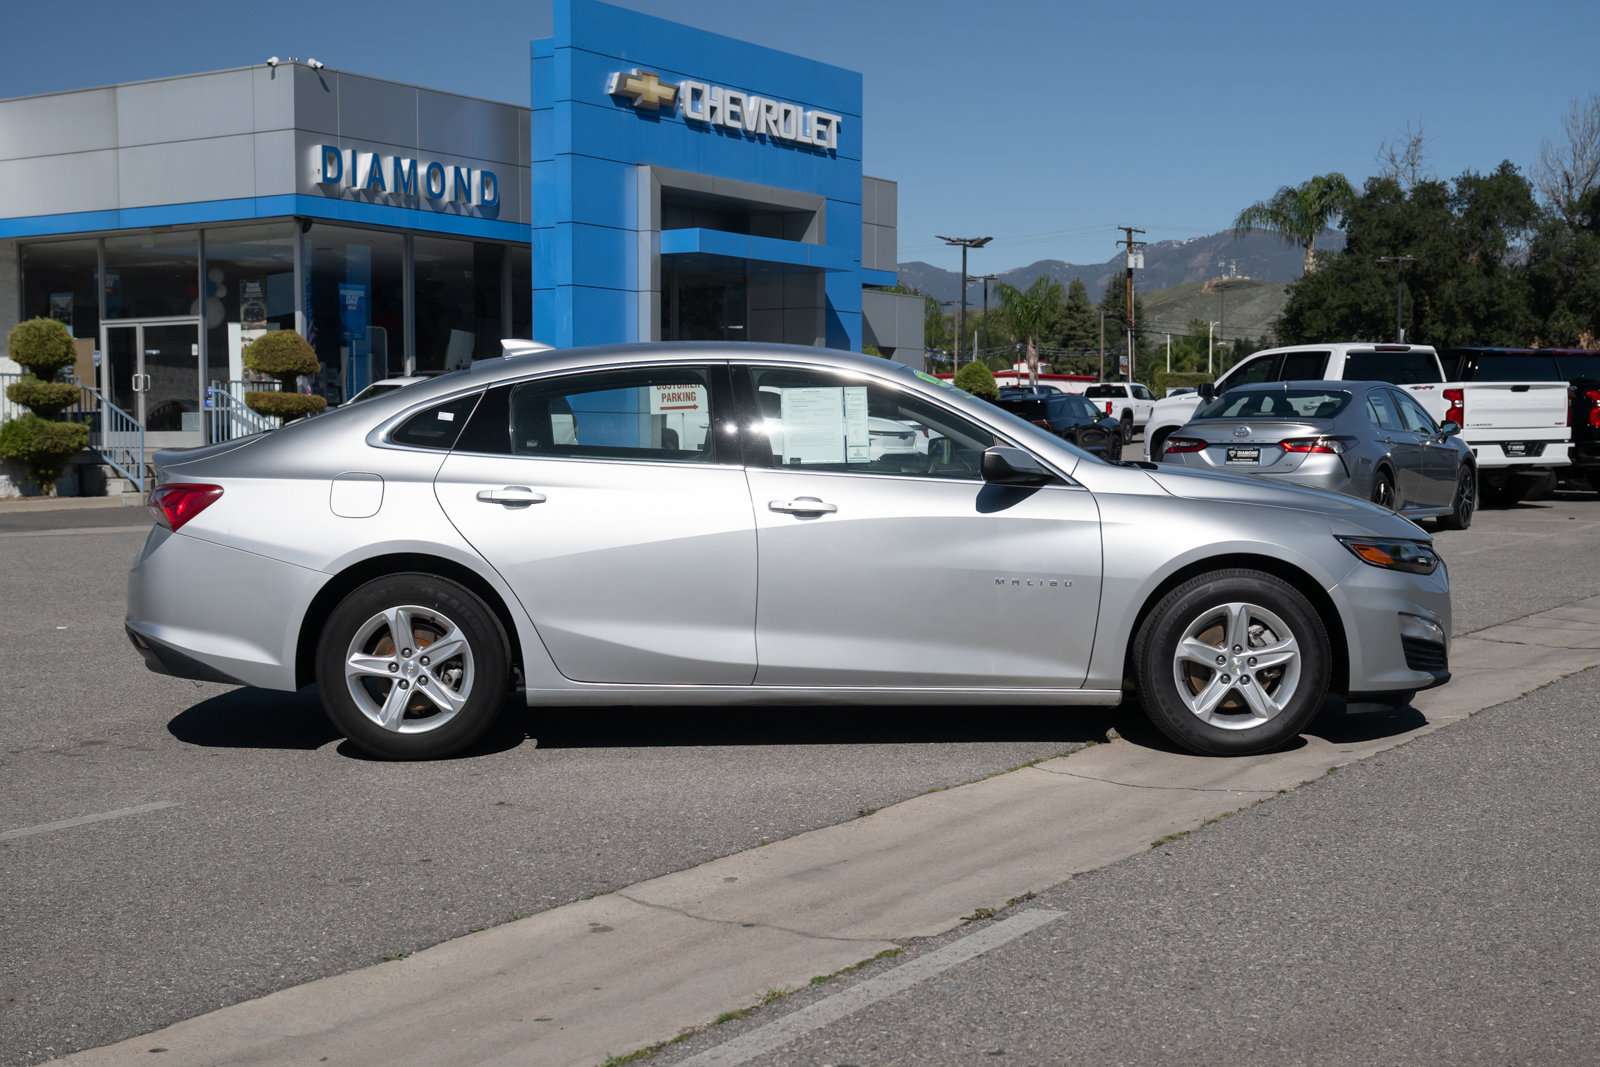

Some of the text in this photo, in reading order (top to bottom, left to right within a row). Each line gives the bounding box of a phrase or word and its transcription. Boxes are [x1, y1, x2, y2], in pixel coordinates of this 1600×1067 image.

[680, 80, 842, 149] CHEVROLET
[318, 145, 498, 207] DIAMOND
[661, 391, 697, 402] PARKING
[994, 577, 1072, 587] MALIBU
